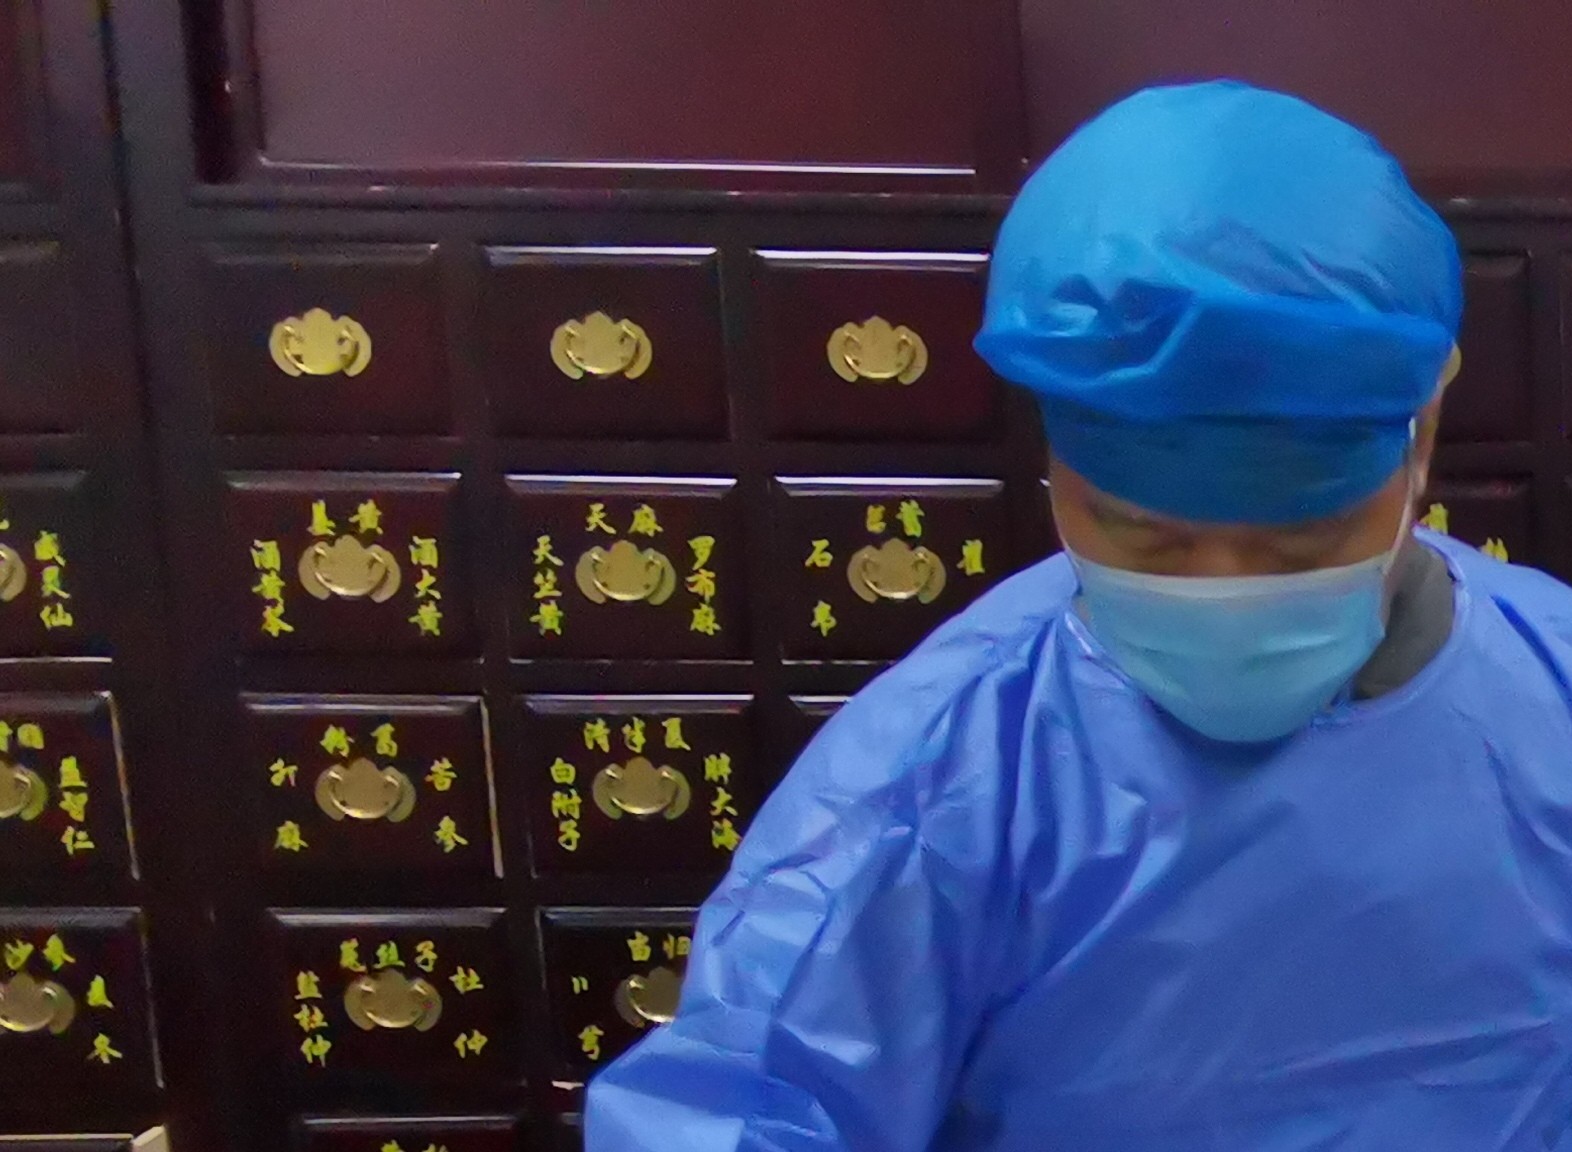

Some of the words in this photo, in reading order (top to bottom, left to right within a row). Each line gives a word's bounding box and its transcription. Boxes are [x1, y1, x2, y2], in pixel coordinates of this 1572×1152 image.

[585, 502, 664, 537] 天麻
[529, 534, 565, 636] 天竺黄
[687, 535, 721, 637] 罗布麻
[549, 757, 583, 851] 白附子
[703, 752, 741, 852] 胖大海
[450, 967, 489, 1059] 杜仲
